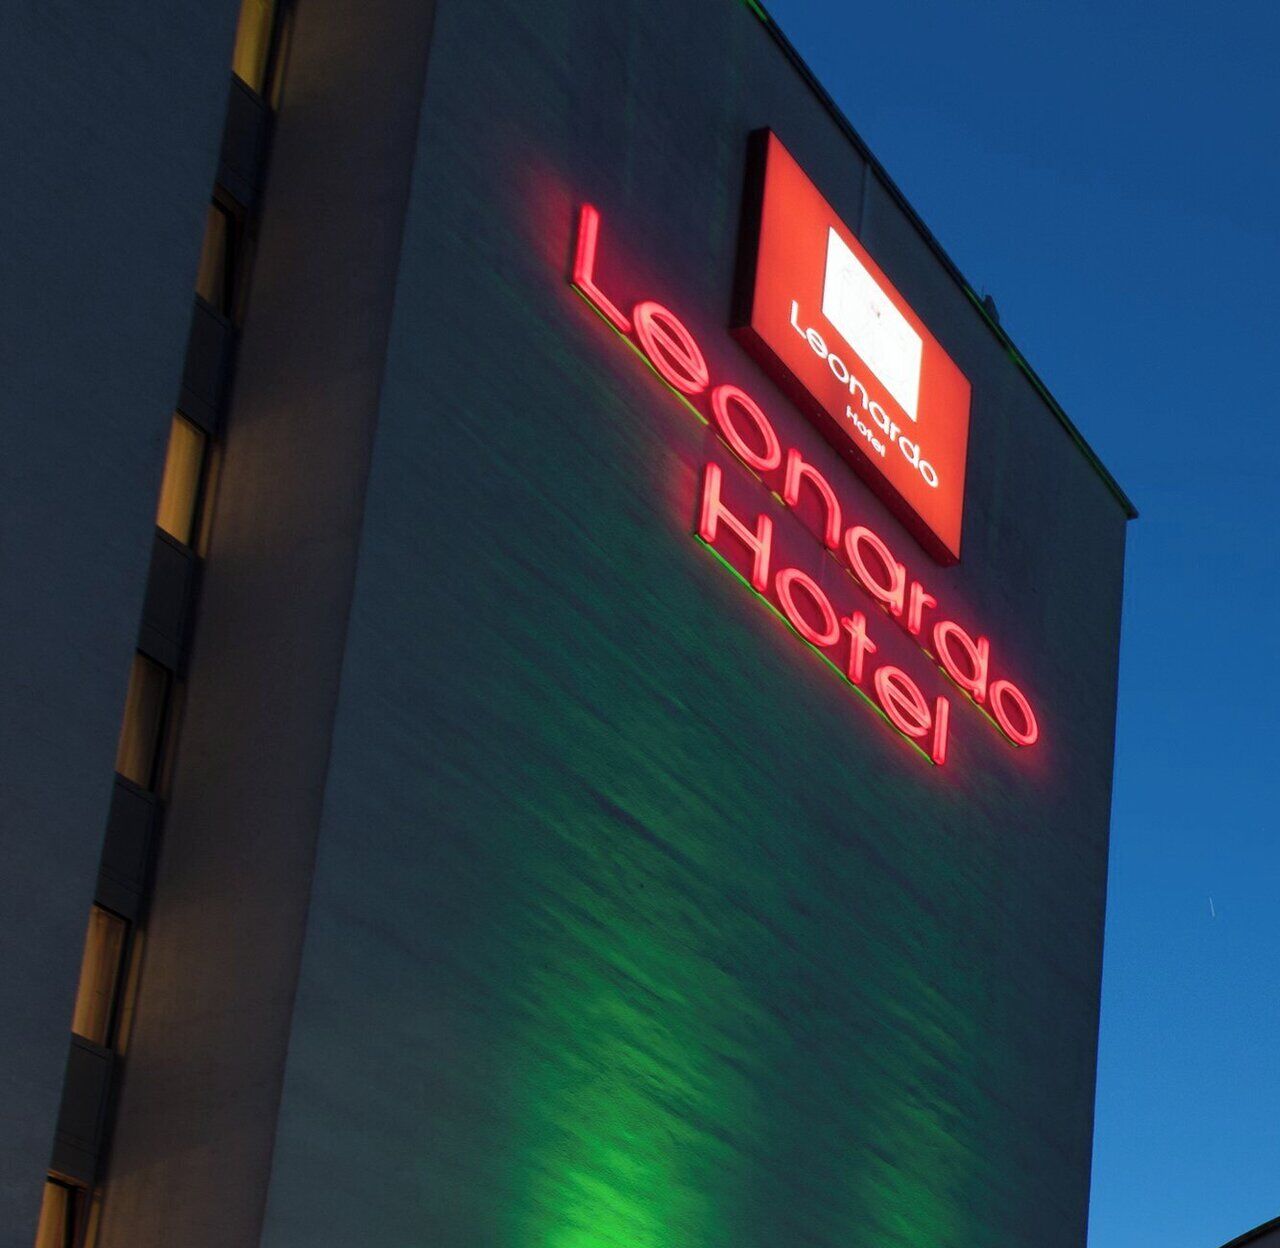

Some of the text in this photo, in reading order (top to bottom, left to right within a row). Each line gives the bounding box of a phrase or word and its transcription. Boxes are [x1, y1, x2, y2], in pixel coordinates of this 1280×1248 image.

[572, 203, 1039, 746] Leonardo
[790, 300, 939, 488] Leonardo
[846, 405, 886, 457] Hotel
[699, 461, 949, 766] Hotel
